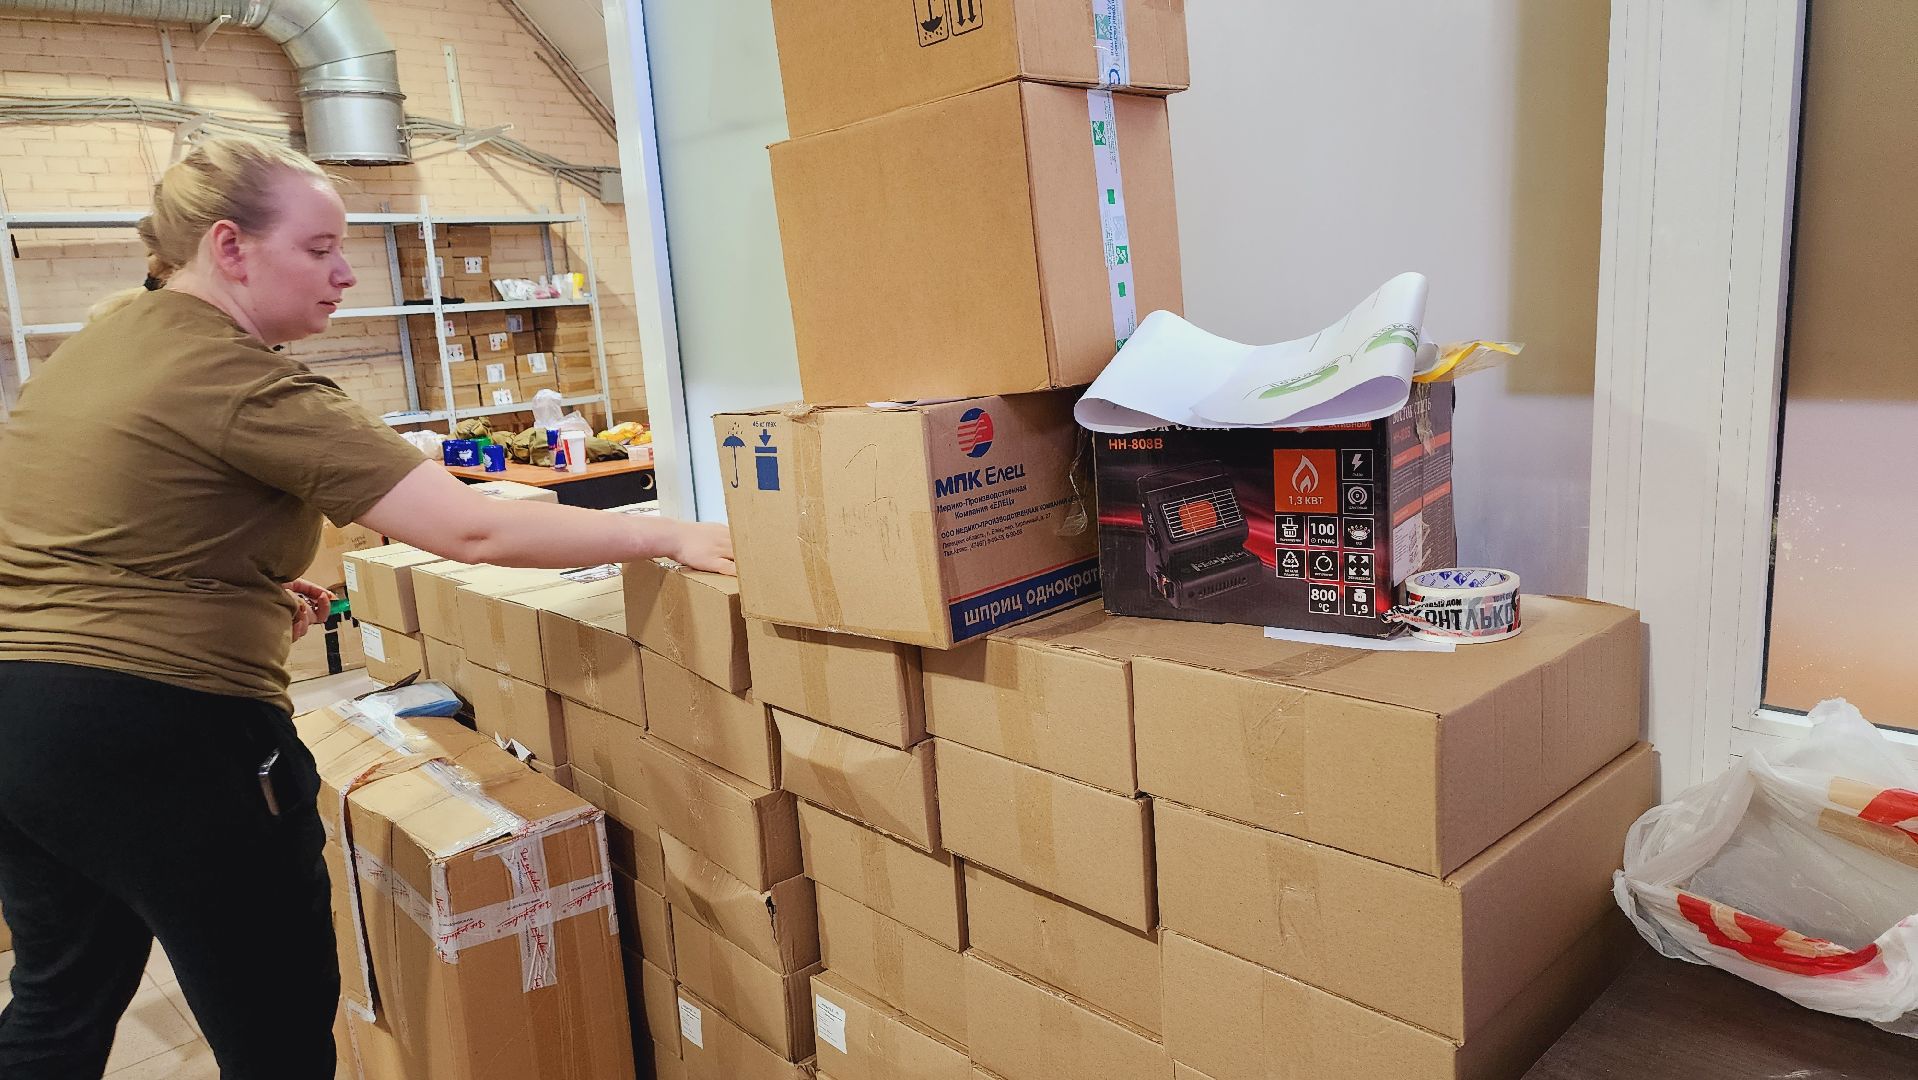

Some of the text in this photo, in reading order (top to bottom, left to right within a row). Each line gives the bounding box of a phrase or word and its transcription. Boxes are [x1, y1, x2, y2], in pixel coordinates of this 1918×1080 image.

[1108, 438, 1164, 450] HH-808B
[935, 463, 1026, 498] МПК Елец
[937, 485, 1028, 513] Медико-Производственная
[1288, 495, 1324, 506] 1,3 КВТ
[955, 505, 989, 520] Компания
[1310, 523, 1335, 536] 100
[1311, 589, 1337, 602] 800
[964, 594, 1023, 626] шприц
[1351, 604, 1369, 615] 1,9
[1446, 599, 1462, 608] ДОМ
